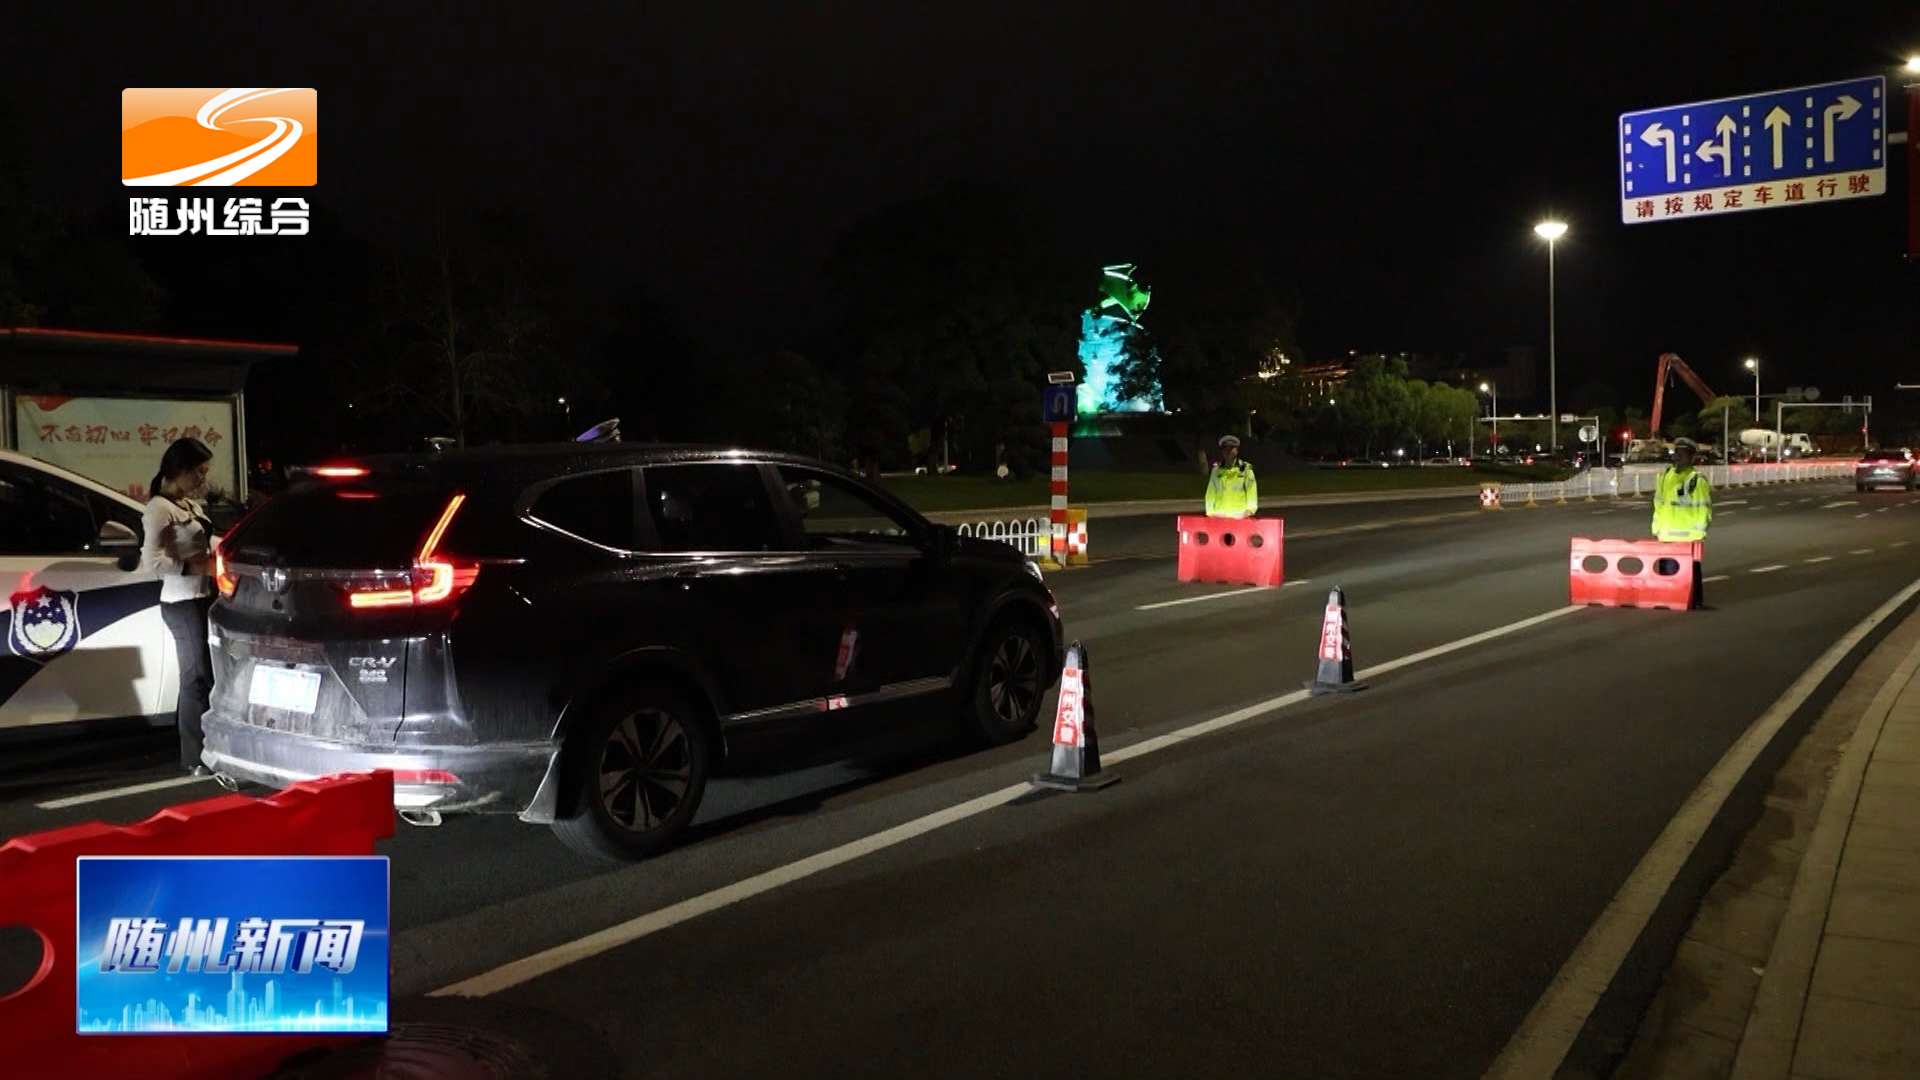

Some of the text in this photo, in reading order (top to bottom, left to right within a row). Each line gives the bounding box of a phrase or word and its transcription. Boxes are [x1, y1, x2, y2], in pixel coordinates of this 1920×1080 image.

[1636, 173, 1870, 218] 请按规定车道行驶
[349, 656, 397, 668] CR-V
